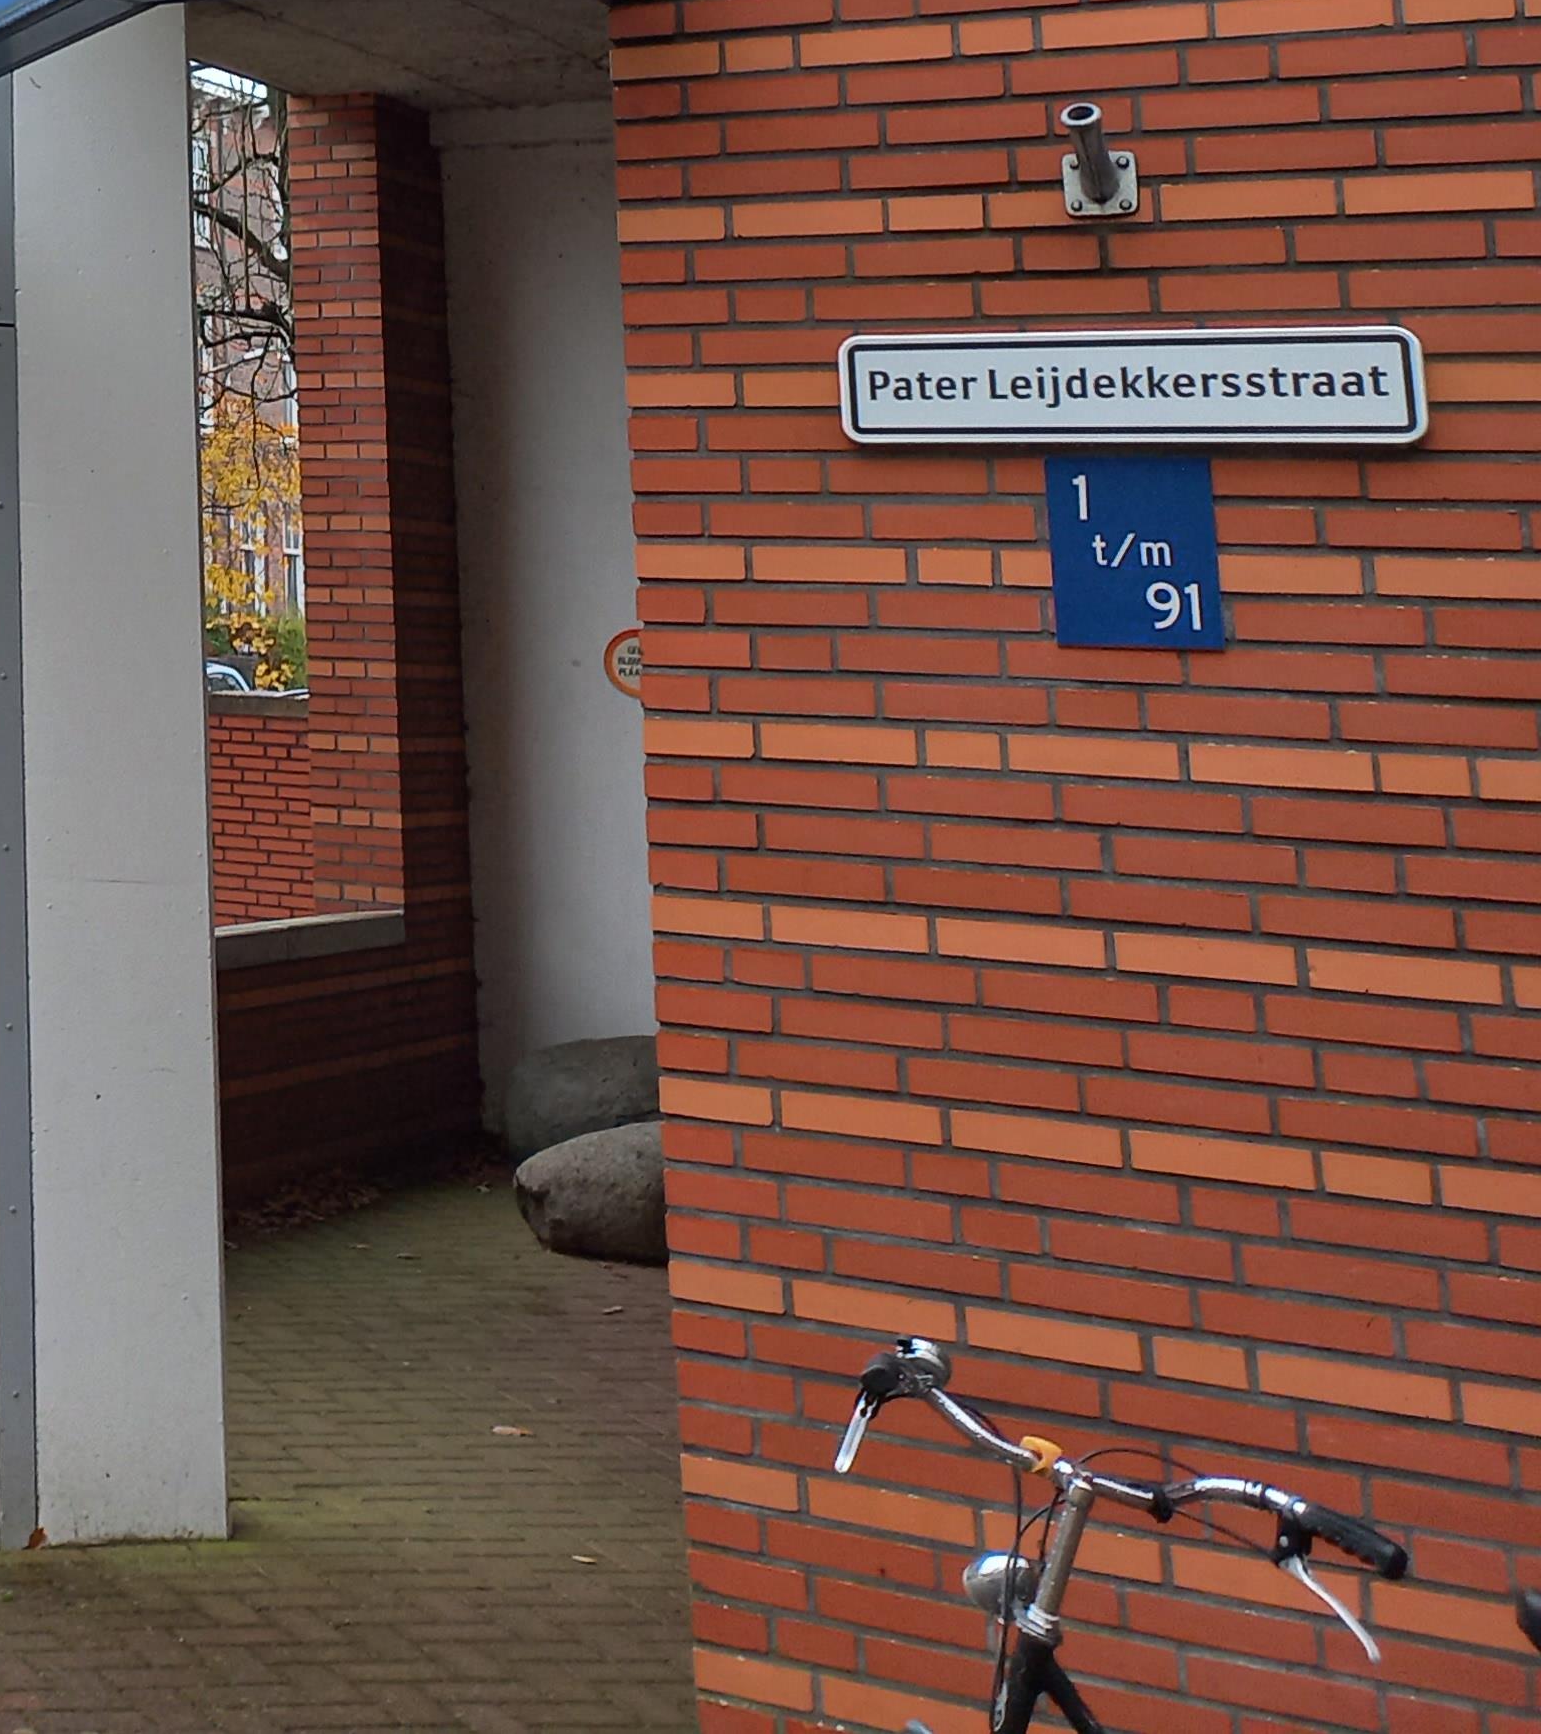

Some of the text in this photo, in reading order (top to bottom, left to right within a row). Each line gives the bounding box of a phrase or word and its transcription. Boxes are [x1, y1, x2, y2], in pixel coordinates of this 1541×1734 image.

[867, 363, 1390, 409] Pater Leijdekkersstraat
[1071, 473, 1090, 521] 1
[1091, 532, 1174, 568] t/m
[1145, 580, 1205, 632] 91
